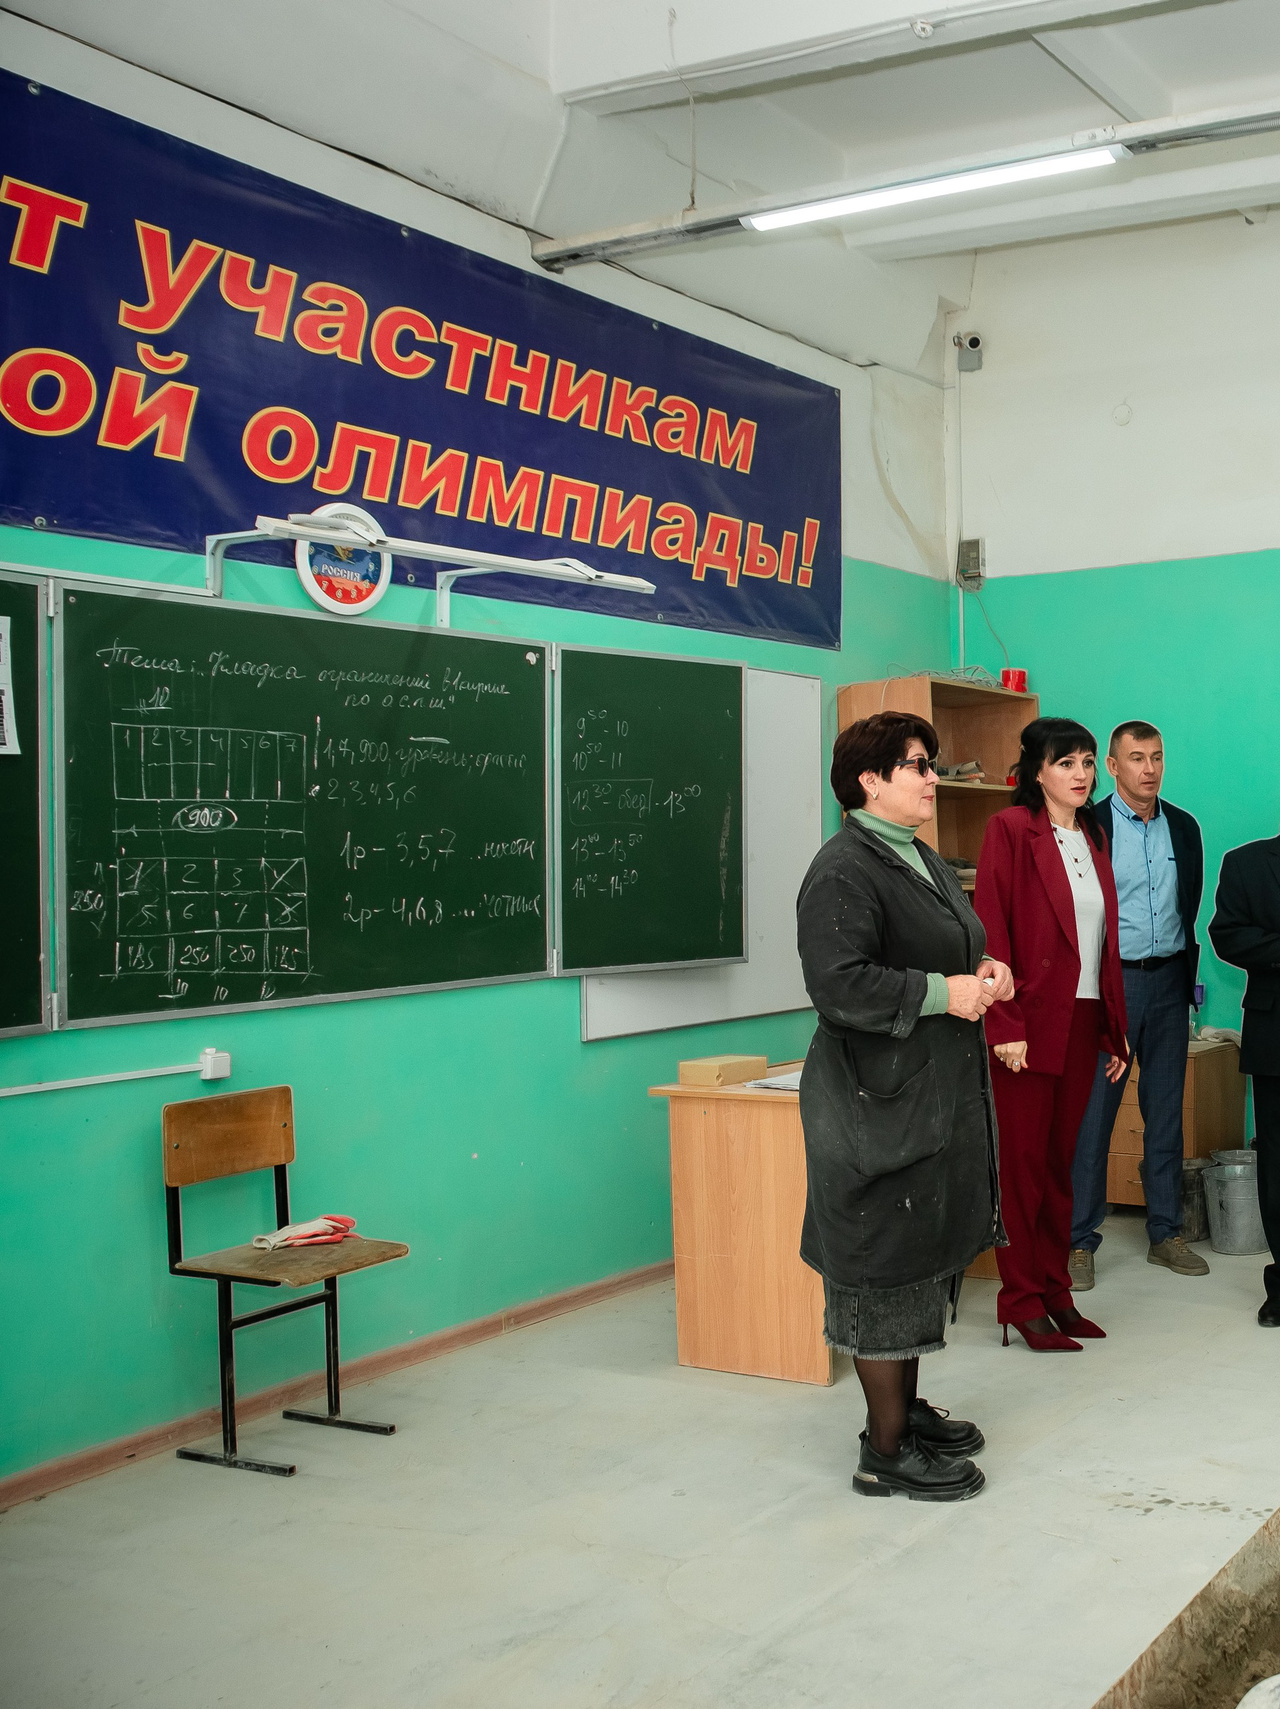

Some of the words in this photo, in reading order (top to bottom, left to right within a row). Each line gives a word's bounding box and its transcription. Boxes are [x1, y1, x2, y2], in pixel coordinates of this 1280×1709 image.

[118, 219, 758, 475] участникам
[0, 342, 199, 462] ой
[242, 406, 820, 588] олимпиады!
[321, 564, 361, 582] РОССИЯ
[152, 728, 163, 746] 2
[184, 807, 223, 828] 900
